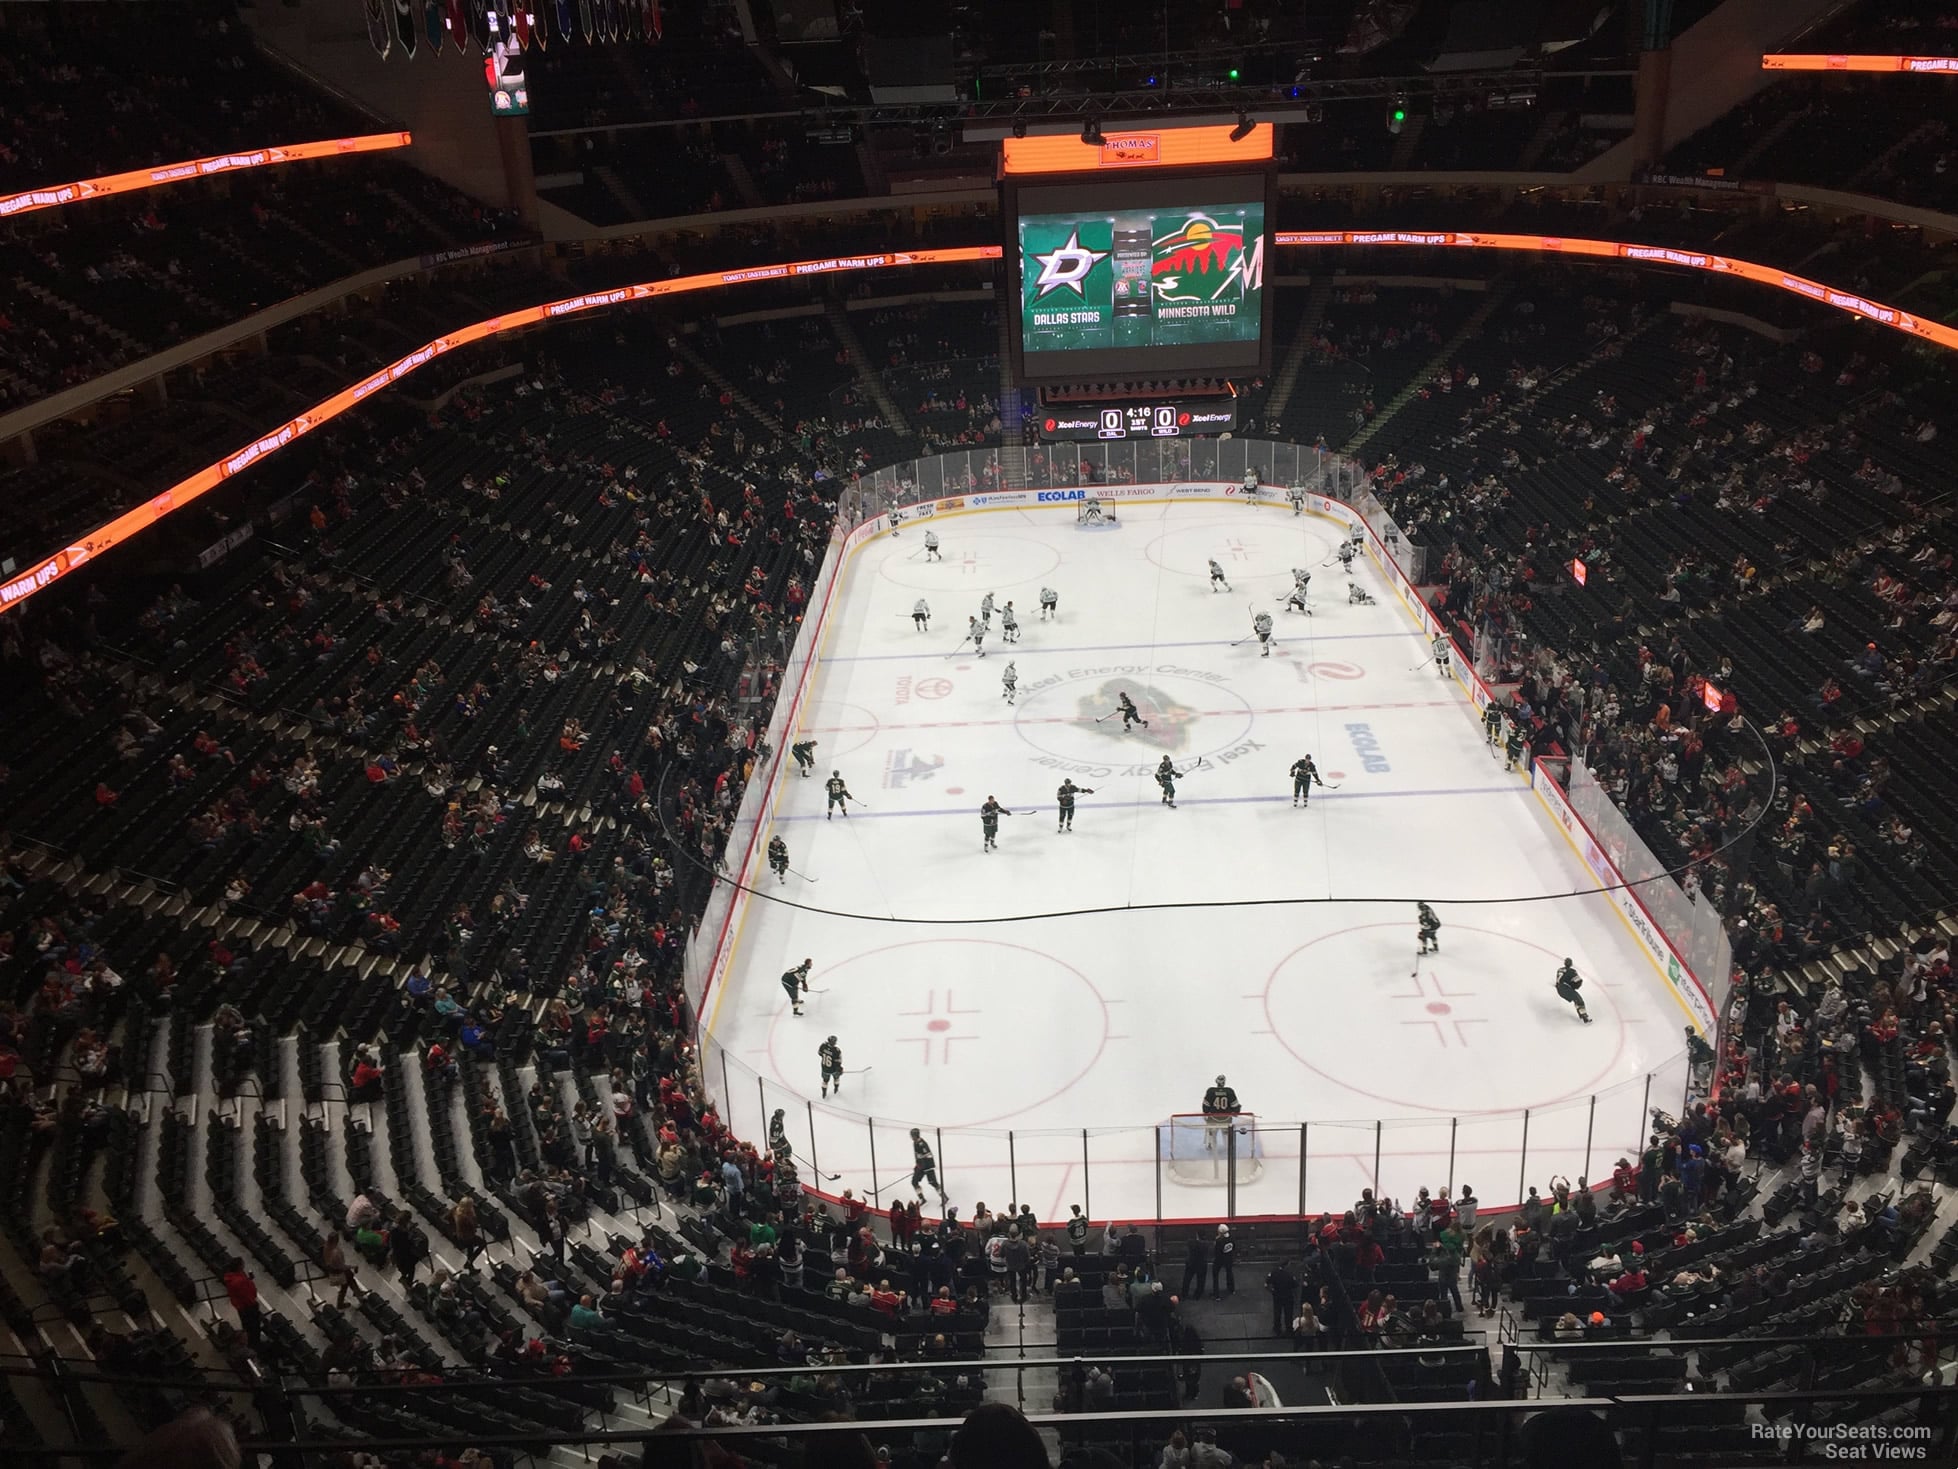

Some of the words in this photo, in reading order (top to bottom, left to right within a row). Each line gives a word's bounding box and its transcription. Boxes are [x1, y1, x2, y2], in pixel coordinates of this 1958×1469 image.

[1910, 60, 1948, 71] PREGAME
[1105, 139, 1152, 150] THOMAS
[203, 157, 230, 173] PREGAME
[250, 152, 264, 165] UPS
[32, 189, 58, 205] WARM
[57, 187, 73, 203] UPS
[1353, 233, 1396, 243] PREGAME
[1398, 234, 1425, 243] WARM
[1427, 235, 1446, 243] UPS
[796, 259, 838, 273] PREGAME
[838, 257, 866, 268] WARM
[866, 256, 885, 267] UPS
[1627, 247, 1665, 259] PREGAME
[1666, 250, 1690, 263] WARM
[1690, 255, 1706, 266] UPS
[550, 299, 585, 315] PREGAME
[585, 295, 609, 305] WARM
[610, 291, 626, 303] UPS
[1034, 313, 1069, 326] DALLAS
[1070, 311, 1100, 324] STARS
[1158, 306, 1210, 319] MINNESOTA
[1212, 304, 1236, 317] WILD
[1105, 413, 1118, 428] 0
[1159, 410, 1172, 425] 0
[1126, 407, 1151, 418] 4:16
[1192, 414, 1210, 423] Xcel
[1209, 413, 1232, 423] Energy
[1057, 421, 1075, 429] Xcel
[1074, 421, 1099, 430] Energy
[227, 443, 260, 474] PREGAME
[258, 435, 279, 453] WARM
[278, 427, 292, 446] UPS
[1038, 490, 1086, 502] ECOLAB
[1127, 488, 1155, 496] FARGO
[1, 575, 37, 602] WARM
[36, 561, 59, 585] UPS
[1020, 674, 1064, 694] Xcel
[1068, 664, 1149, 680] Energy
[1155, 664, 1233, 683] Center
[895, 675, 912, 705] TOYOTA
[1217, 739, 1266, 764] Xcel
[1344, 723, 1391, 774] ECOLAB
[1030, 755, 1112, 778] Center
[831, 784, 841, 794] 19
[822, 1053, 832, 1067] 16
[1213, 1096, 1228, 1110] 40
